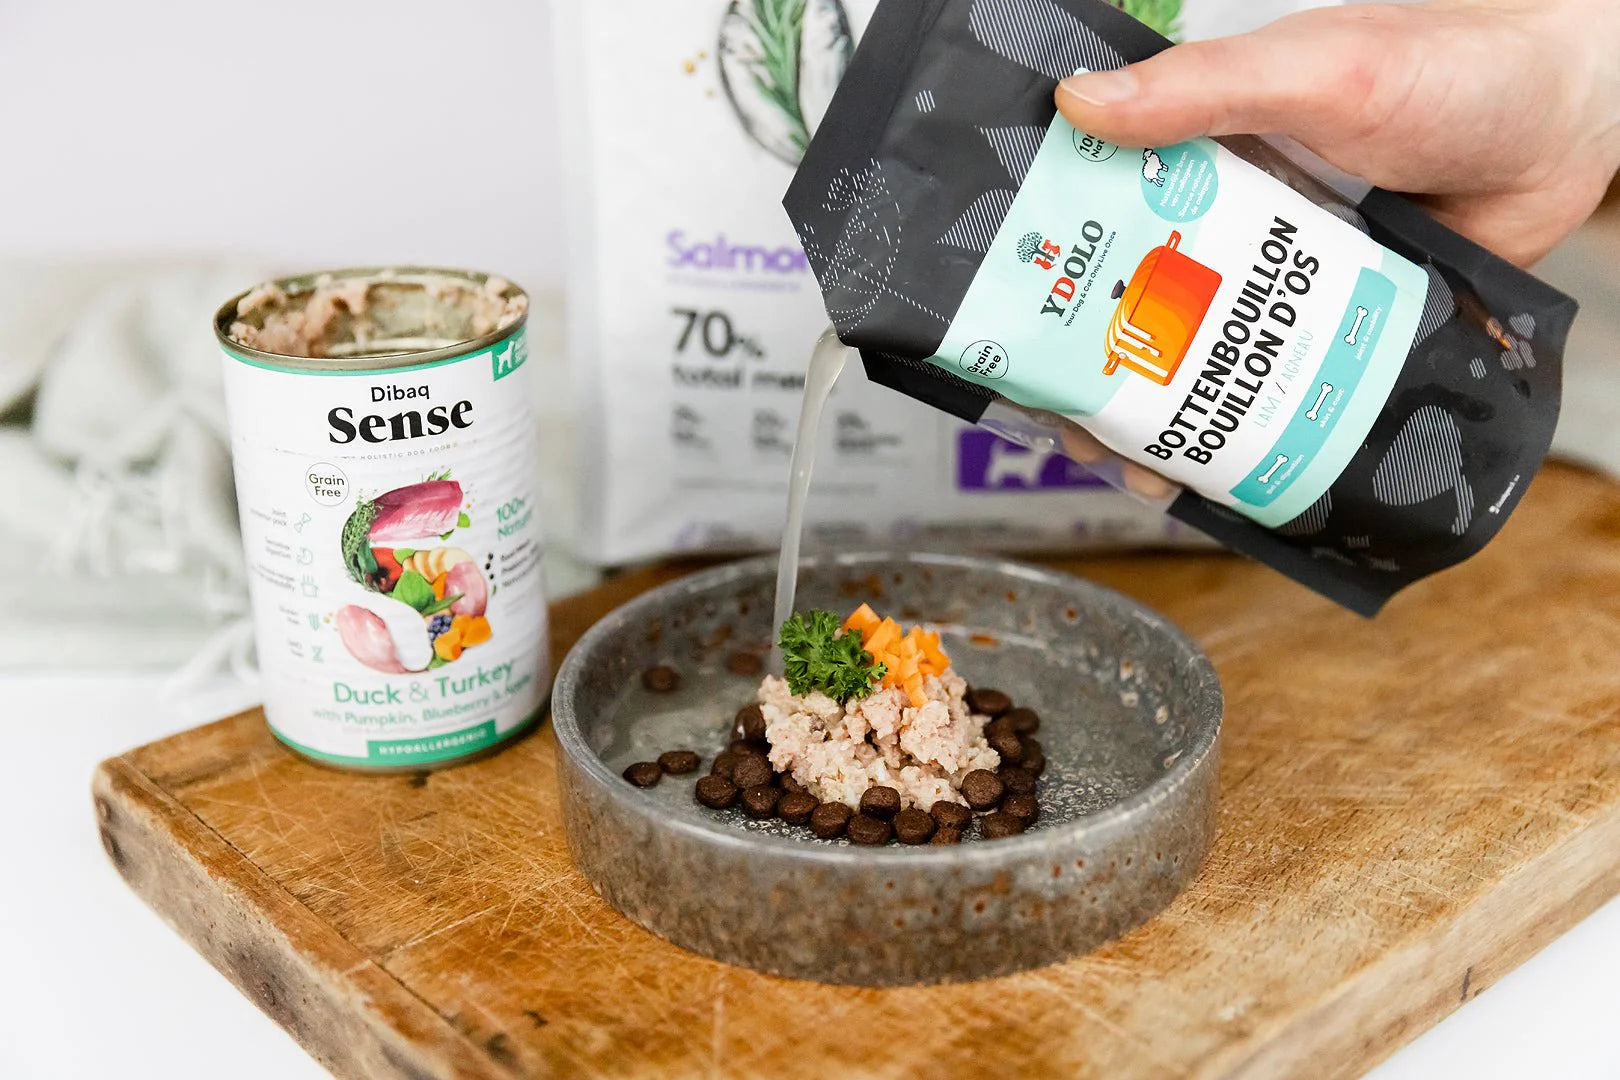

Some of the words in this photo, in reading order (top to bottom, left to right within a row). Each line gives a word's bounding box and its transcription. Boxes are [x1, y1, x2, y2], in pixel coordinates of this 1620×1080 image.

[1171, 193, 1180, 207] van
[1178, 192, 1194, 218] Source
[1191, 205, 1199, 215] de
[1040, 219, 1104, 318] YDOLO
[1064, 312, 1077, 327] Your
[1073, 298, 1085, 313] Dog
[1083, 278, 1094, 292] Cat
[1090, 262, 1103, 278] Only
[1098, 249, 1108, 262] Live
[1105, 231, 1117, 249] Once
[1144, 216, 1298, 461] BOTTENBOUILLON
[966, 345, 993, 373] Grain
[979, 355, 1001, 377] Free
[1254, 396, 1281, 428] LAM
[1281, 329, 1314, 381] AGNEAU
[371, 384, 430, 402] Dibaq
[1183, 328, 1285, 465] BOUILLON
[1332, 388, 1345, 406] coat
[327, 399, 474, 444] Sense
[360, 452, 404, 461] HOLISTIC
[408, 448, 425, 457] DOG
[308, 473, 345, 487] Grain
[314, 485, 342, 498] Free
[333, 681, 403, 706] Duck
[408, 681, 430, 701] &
[433, 661, 514, 698] Turkey
[422, 697, 490, 721] Blueberry
